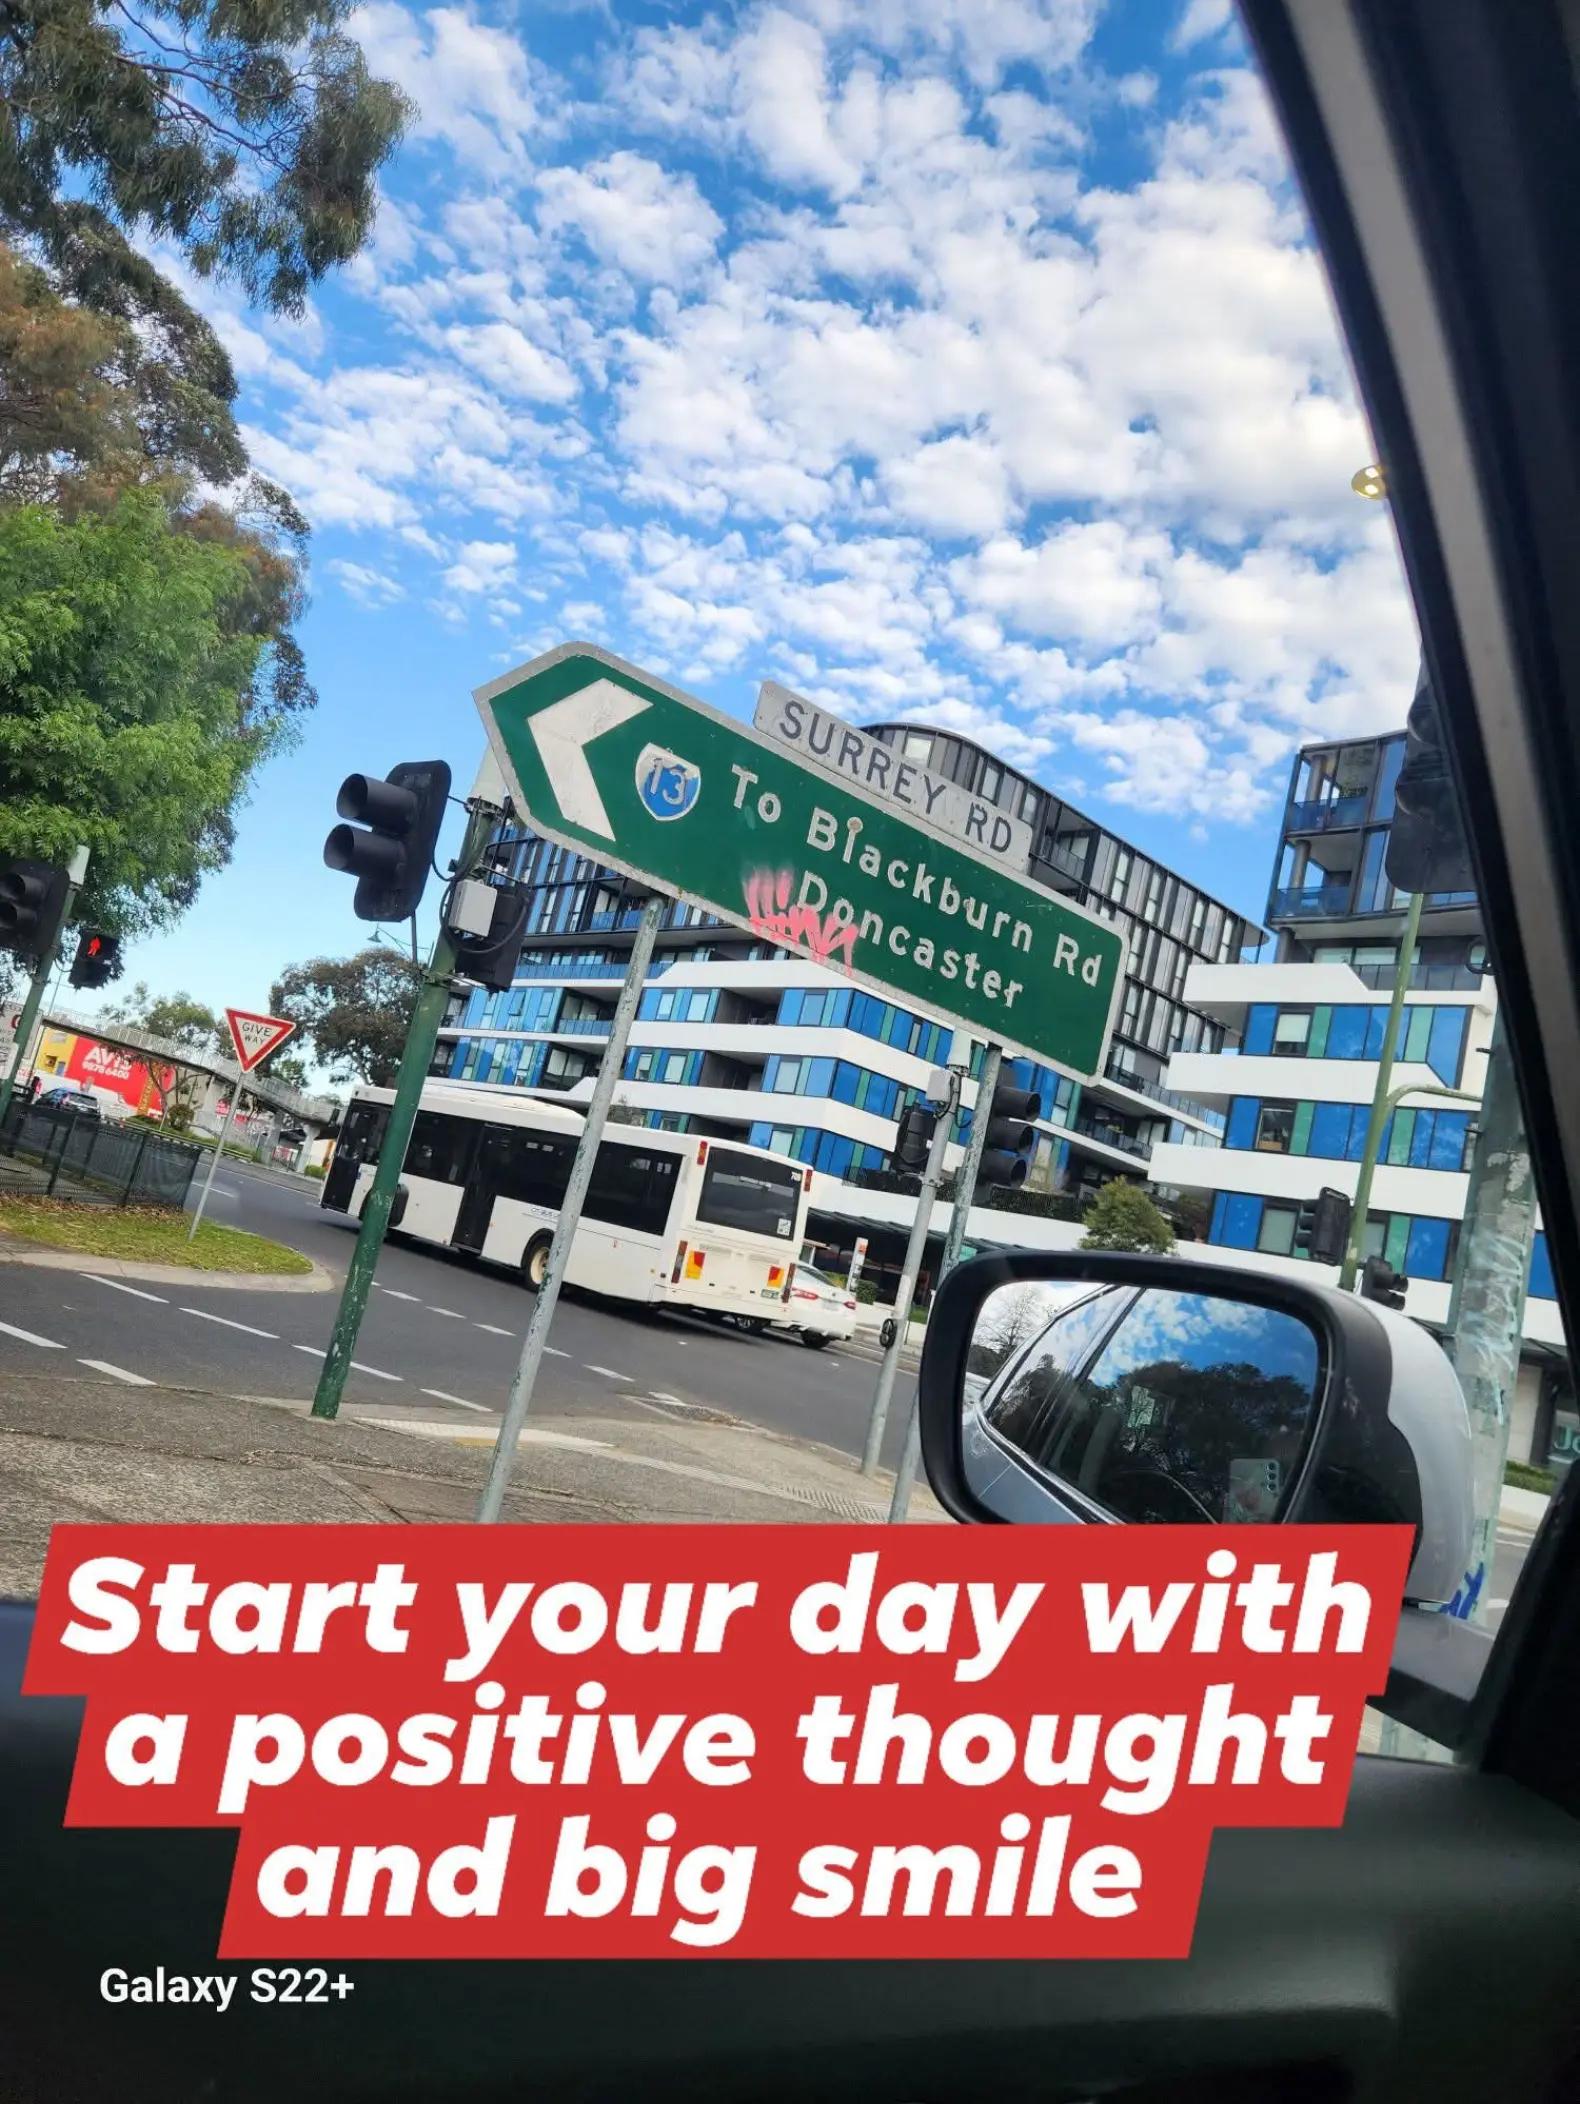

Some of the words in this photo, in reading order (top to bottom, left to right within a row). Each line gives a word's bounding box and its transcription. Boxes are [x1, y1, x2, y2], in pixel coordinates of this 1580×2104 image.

[650, 757, 686, 805] 13
[780, 701, 947, 815] SURREY
[965, 802, 1012, 853] RD
[731, 763, 782, 823] To
[806, 806, 1034, 954] Blackburn
[1053, 932, 1103, 988] Rd
[796, 869, 1024, 1009] Doncaster
[242, 1021, 273, 1037] GIVE
[244, 1034, 266, 1045] WAY
